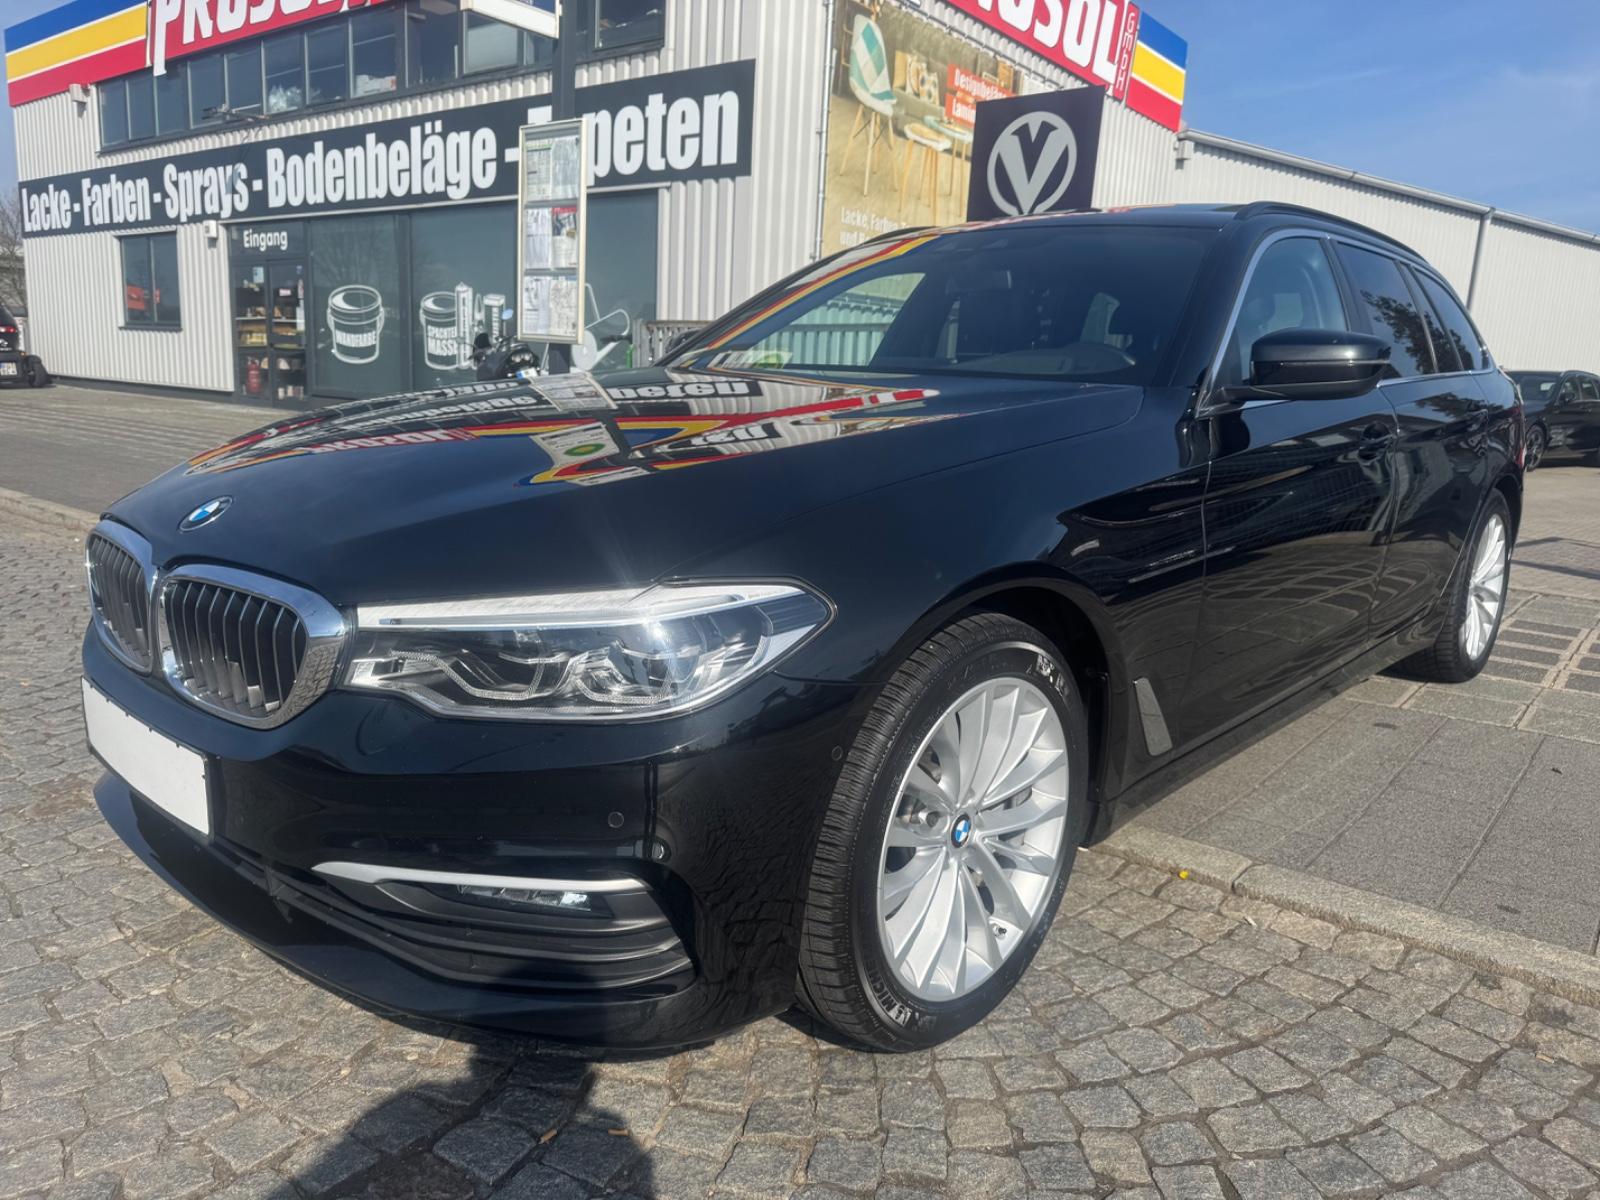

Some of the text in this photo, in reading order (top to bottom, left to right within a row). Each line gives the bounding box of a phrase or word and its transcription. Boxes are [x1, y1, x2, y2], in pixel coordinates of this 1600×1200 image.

[21, 184, 71, 232] Lacke
[81, 173, 151, 227] Farben
[163, 162, 249, 223] Sprays
[266, 119, 497, 208] Bodenbeläge
[527, 90, 739, 187] peten
[243, 229, 288, 252] Eingang
